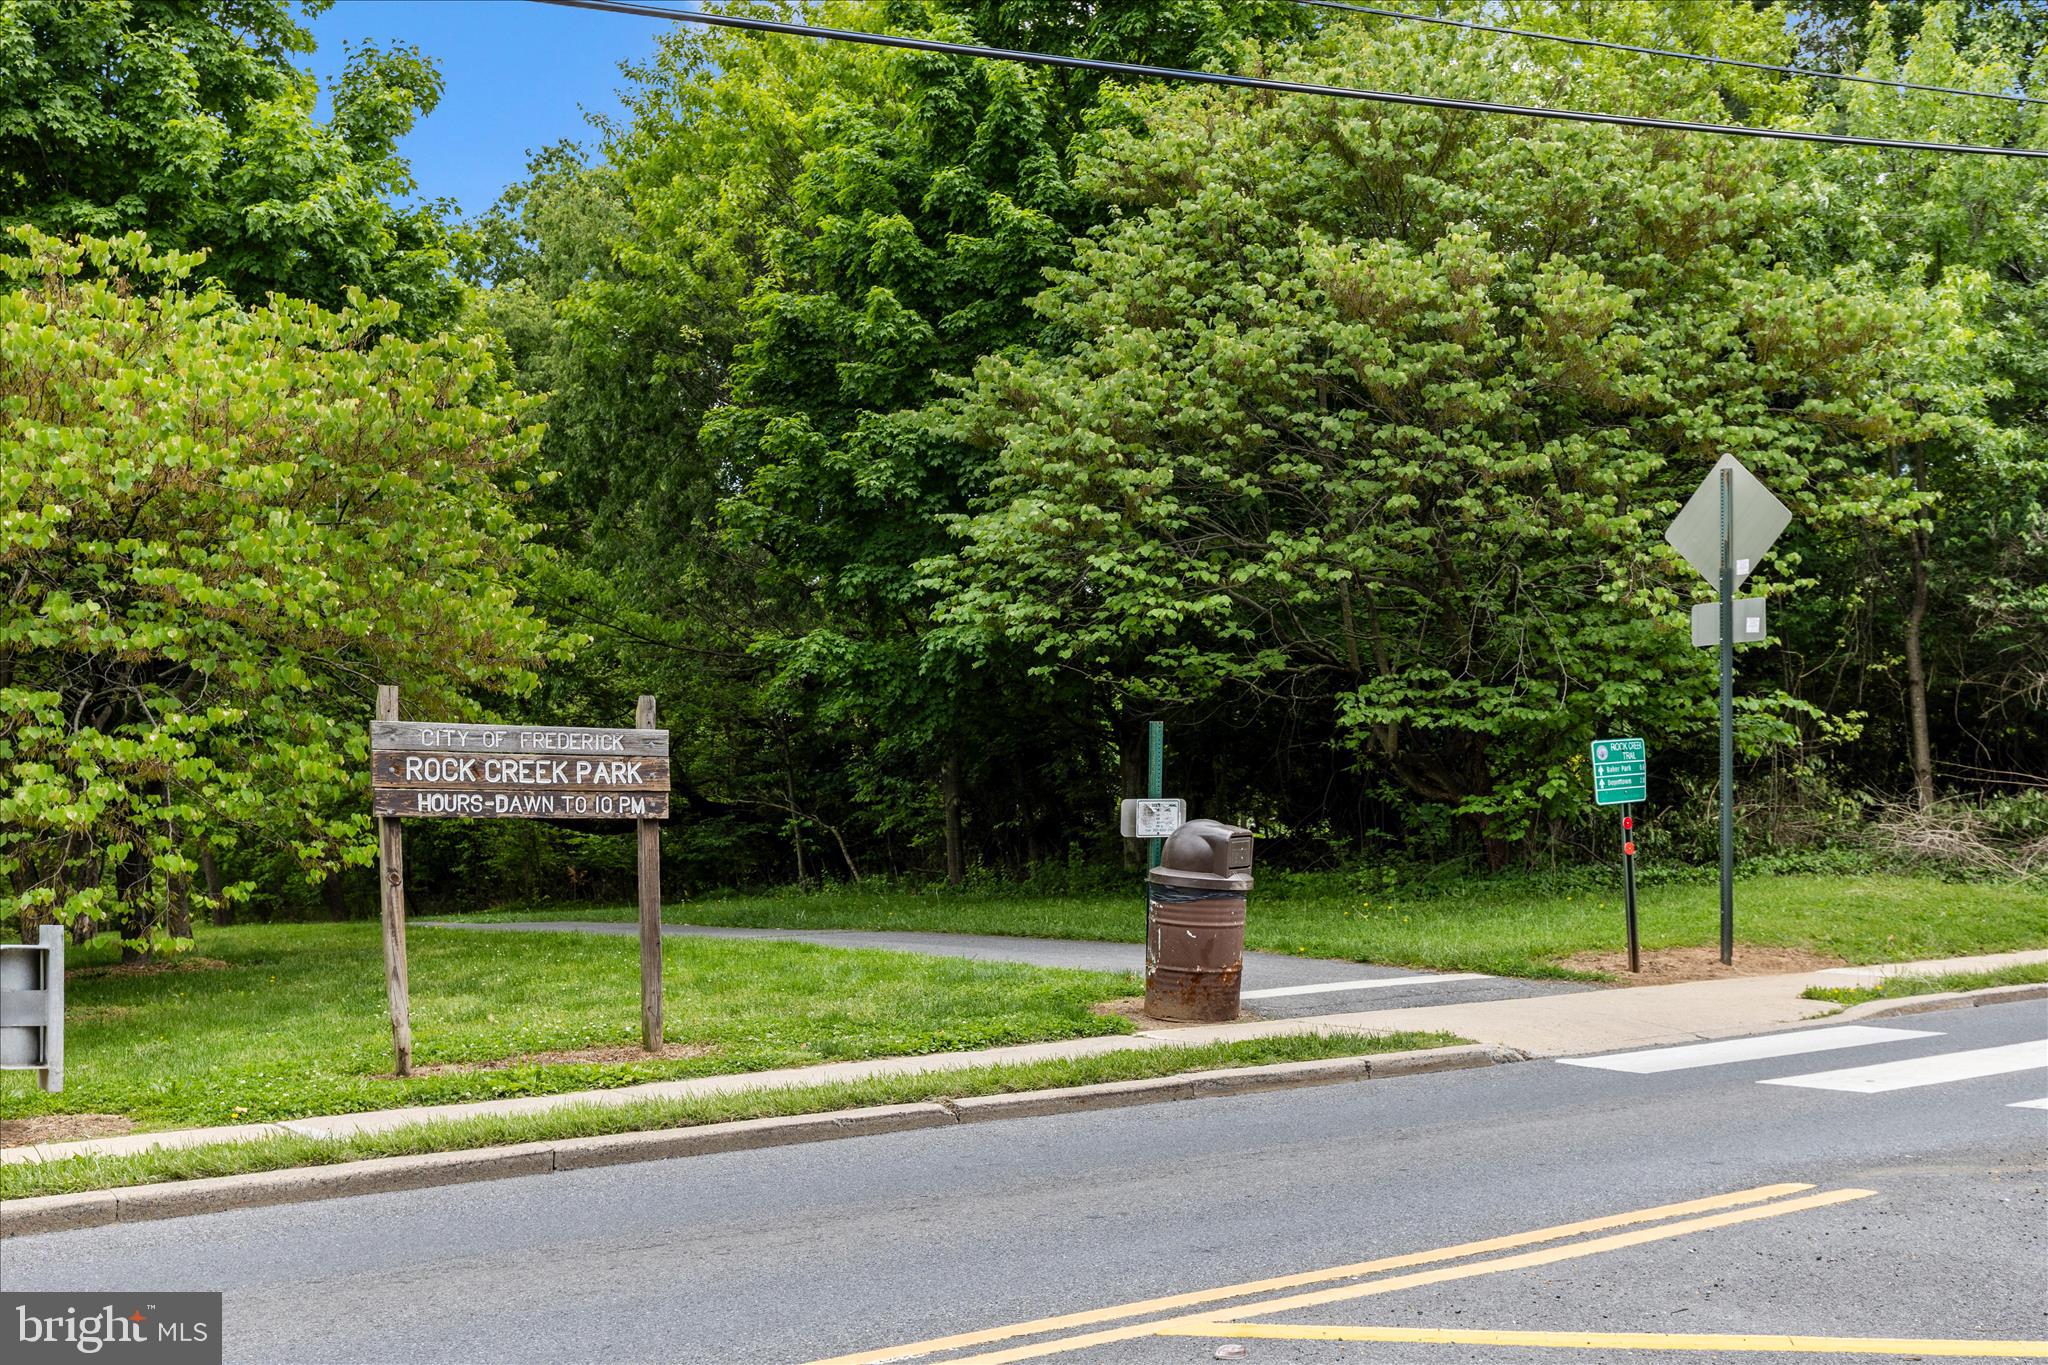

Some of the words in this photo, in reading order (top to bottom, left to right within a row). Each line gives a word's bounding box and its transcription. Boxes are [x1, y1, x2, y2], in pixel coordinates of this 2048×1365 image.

[421, 728, 469, 747] CITY
[482, 730, 507, 748] OF
[520, 731, 625, 751] FREDERICK
[1611, 742, 1628, 751] ROCK
[1628, 741, 1642, 750] CREEK
[1623, 752, 1636, 760] TRAIL
[405, 756, 477, 782] ROCK
[484, 758, 569, 784] CREEK
[576, 760, 644, 785] PARK
[417, 792, 554, 814] HOURS-DAWN
[561, 795, 587, 814] TO
[595, 796, 613, 814] 10
[619, 796, 646, 815] PM
